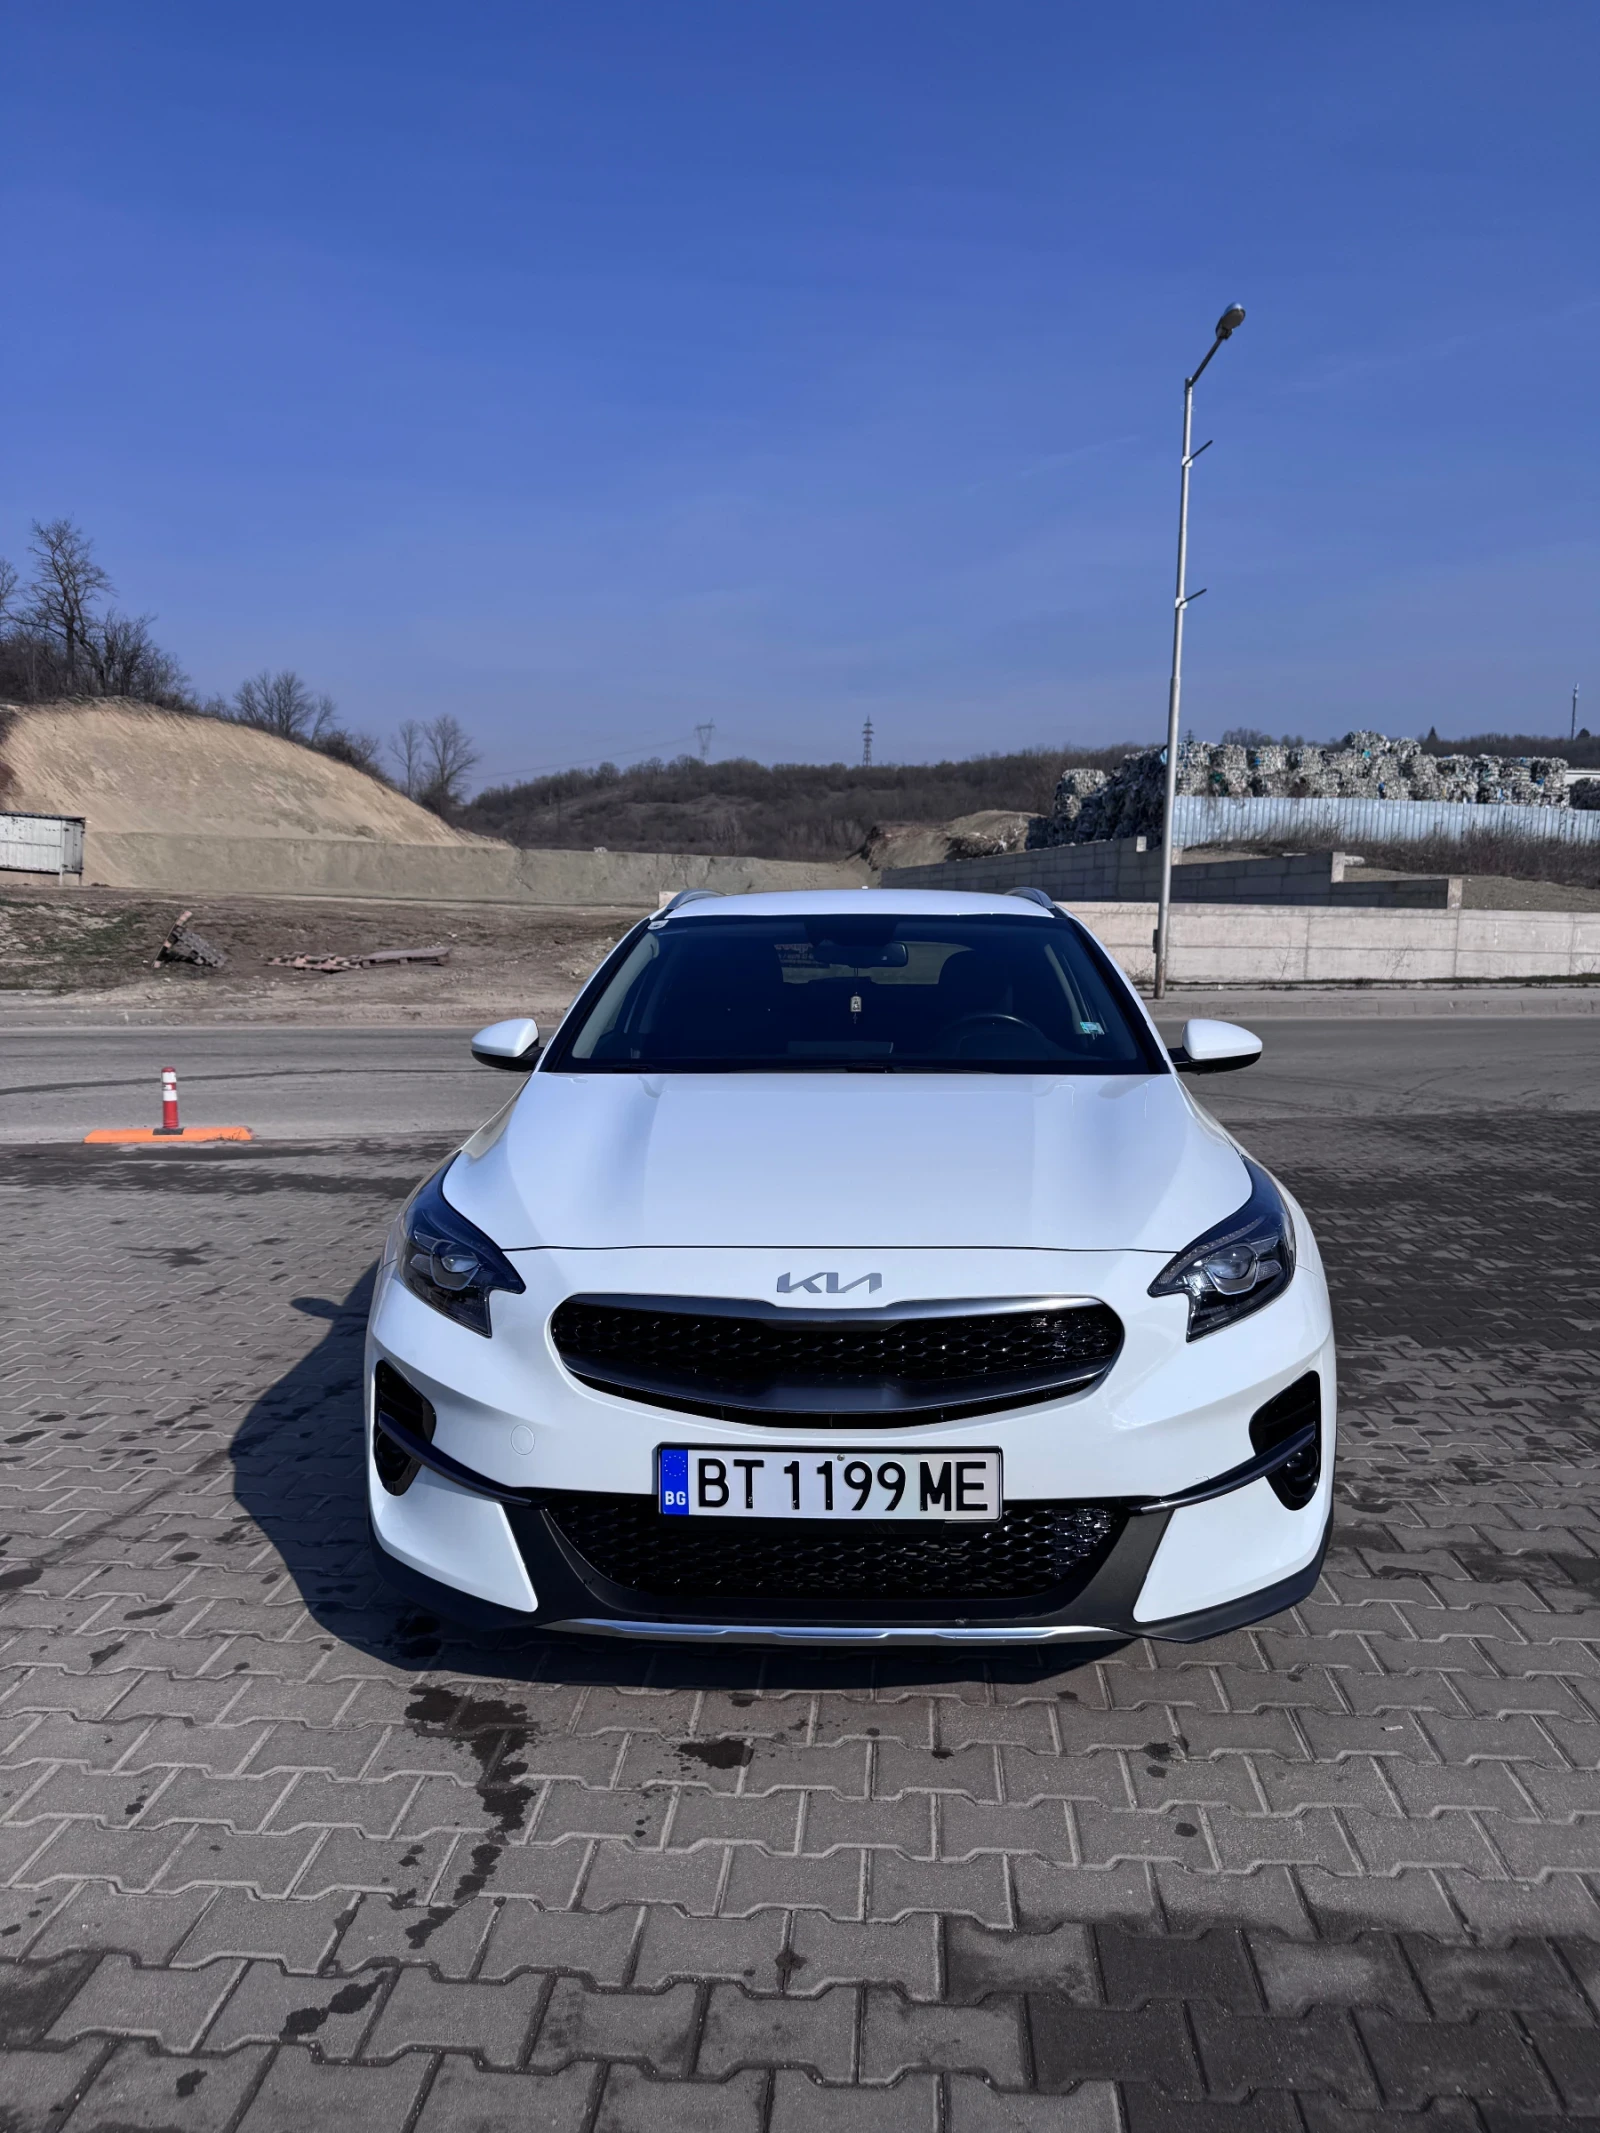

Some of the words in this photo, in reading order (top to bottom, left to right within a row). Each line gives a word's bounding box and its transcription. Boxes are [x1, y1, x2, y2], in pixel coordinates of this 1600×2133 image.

[777, 1271, 883, 1295] KIA
[697, 1457, 765, 1509] BT
[783, 1460, 907, 1512] 1199
[919, 1460, 989, 1512] ME
[664, 1490, 687, 1506] BG
